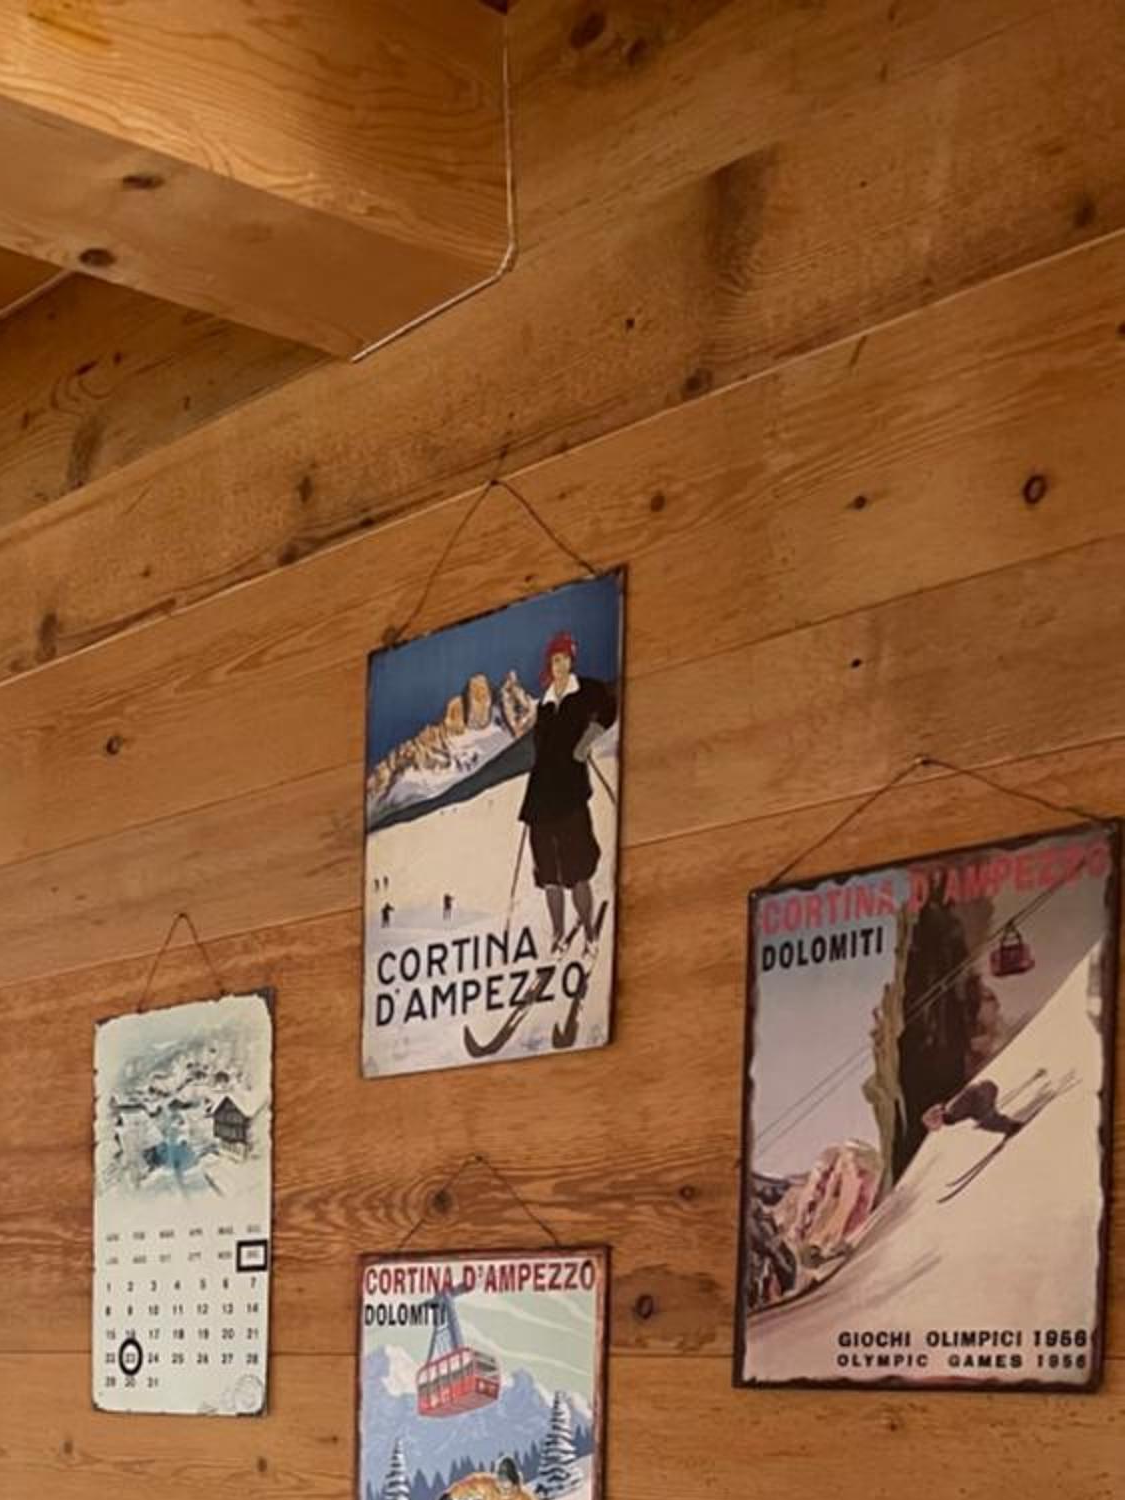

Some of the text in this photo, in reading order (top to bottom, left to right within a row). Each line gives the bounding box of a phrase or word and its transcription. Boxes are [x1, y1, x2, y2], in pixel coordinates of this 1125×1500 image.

[762, 879, 896, 935] CORTINA
[377, 927, 537, 985] CORTINA
[762, 926, 883, 971] DOLOMITI
[376, 961, 585, 1026] D'AMPEZZO
[107, 1283, 111, 1292] 1
[127, 1281, 133, 1292] 2
[151, 1280, 157, 1291] 3
[174, 1280, 180, 1290] 4
[251, 1277, 256, 1288] 7
[366, 1260, 595, 1295] CORTINA D'AMPEZZO
[148, 1305, 159, 1315] 10
[173, 1305, 183, 1315] 11
[197, 1304, 208, 1314] 12
[364, 1302, 446, 1327] DOLOMITI
[149, 1329, 159, 1339] 17
[222, 1328, 234, 1339] 20
[838, 1330, 1087, 1347] GIOCHI OLIMPICI 1956
[837, 1354, 1086, 1368] OLYMPIC GAMES 1956
[148, 1377, 159, 1388] 31
